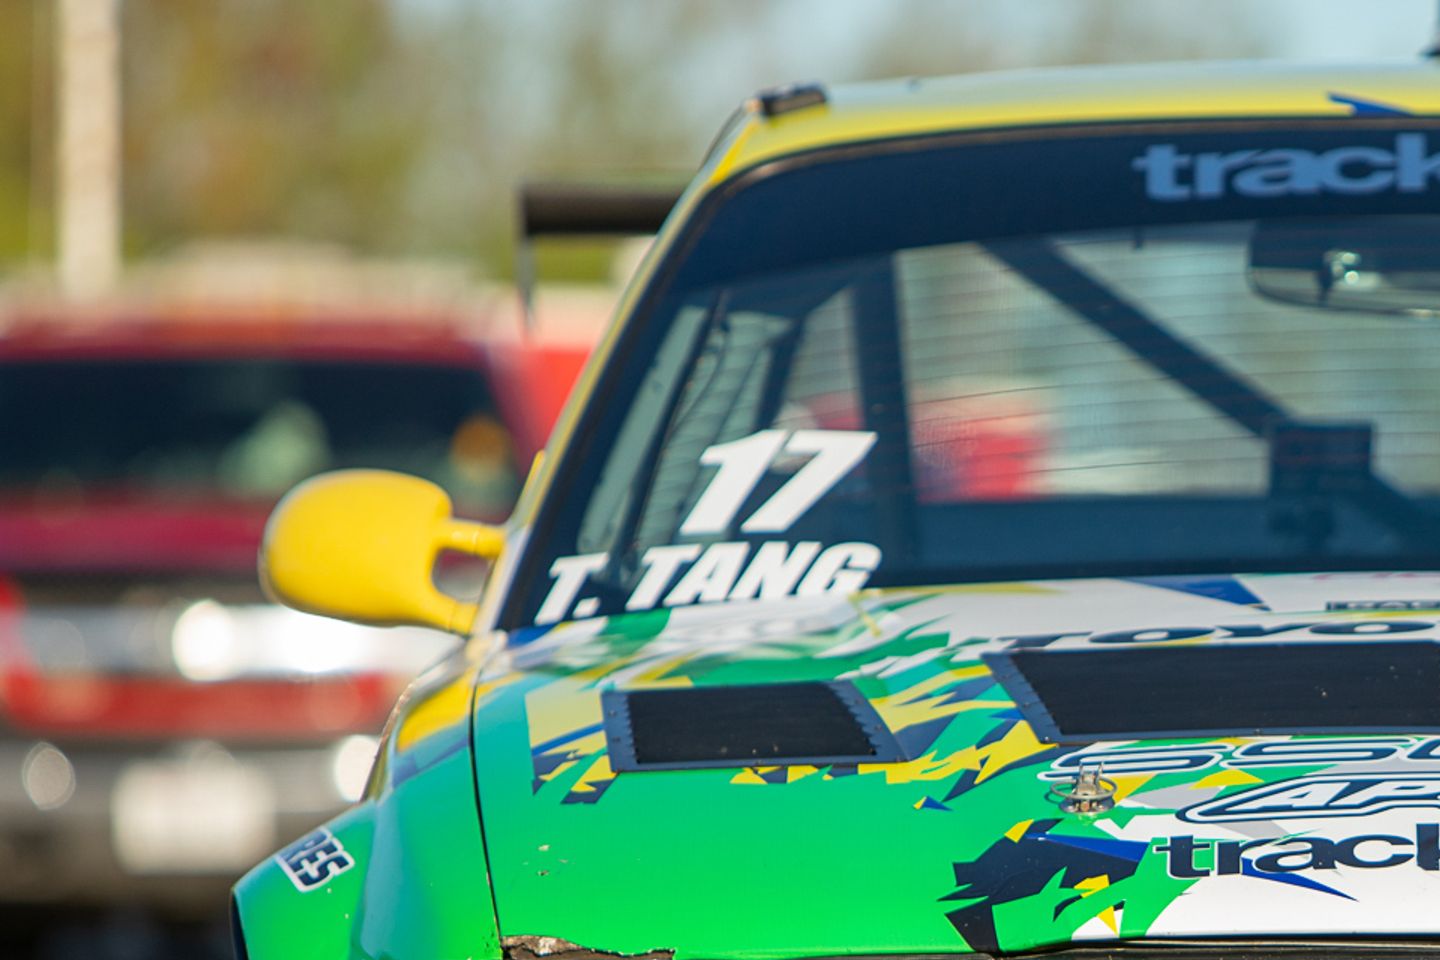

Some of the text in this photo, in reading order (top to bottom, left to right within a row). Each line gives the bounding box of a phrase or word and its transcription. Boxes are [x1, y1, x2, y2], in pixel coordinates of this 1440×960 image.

[680, 428, 878, 535] 17
[534, 540, 882, 626] T. TANG
[993, 619, 1438, 650] TOYO
